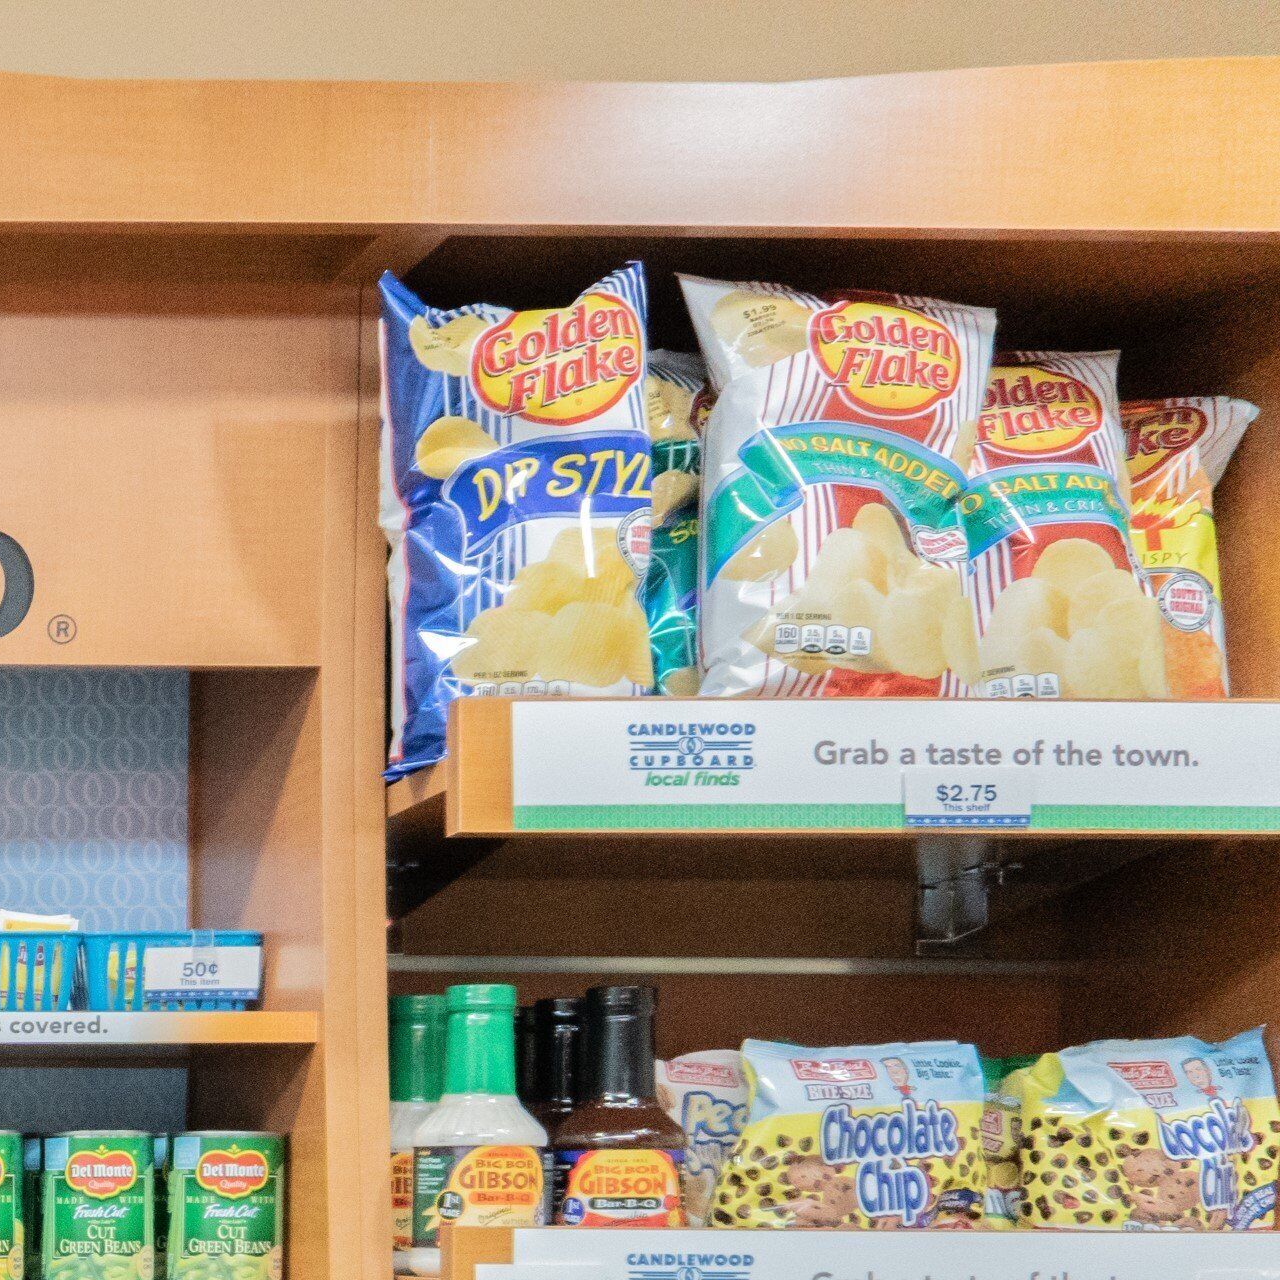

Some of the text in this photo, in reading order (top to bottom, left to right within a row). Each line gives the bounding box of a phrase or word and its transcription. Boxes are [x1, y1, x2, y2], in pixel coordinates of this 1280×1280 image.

[480, 300, 634, 379] Golden
[821, 314, 952, 360] Golden
[834, 347, 950, 390] Flake
[505, 342, 638, 418] Flake
[627, 722, 756, 736] CANDLEWOOD
[628, 754, 754, 768] CUPBOARD
[813, 740, 1200, 767] Grab a taste of the town.
[644, 770, 740, 786] local finds
[936, 783, 998, 803] $2.75
[942, 803, 990, 813] This shelf
[181, 961, 219, 979] 50¢
[8, 1016, 110, 1035] covered.
[820, 1099, 958, 1165] Chocolate
[475, 1159, 534, 1169] BIG BOB
[594, 1164, 659, 1175] BIG BOB
[458, 1167, 539, 1190] GIBSON
[579, 1174, 667, 1196] GIBSON
[477, 1192, 531, 1202] Bar-B-Q
[857, 1158, 928, 1226] Chip
[87, 1225, 115, 1240] CUT
[218, 1225, 247, 1240] CUT
[60, 1239, 142, 1254] GREEN BEANS
